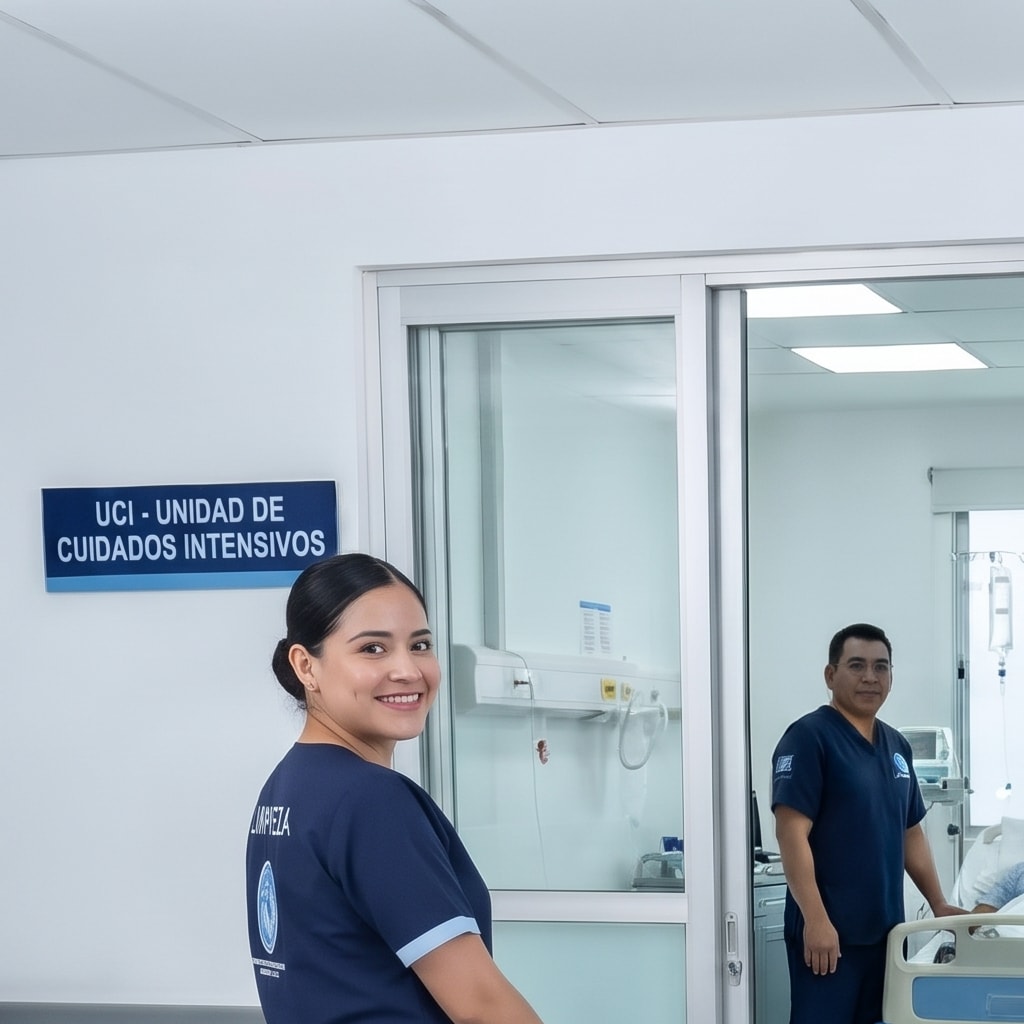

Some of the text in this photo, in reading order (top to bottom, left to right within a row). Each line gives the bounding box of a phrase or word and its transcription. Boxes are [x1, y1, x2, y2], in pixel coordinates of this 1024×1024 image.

[95, 500, 134, 527] UCI
[155, 497, 245, 525] UNIDAD
[252, 496, 285, 522] DE
[57, 530, 326, 562] CUIDADOS INTENSIVOS
[251, 805, 291, 837] LIMPIEZA
